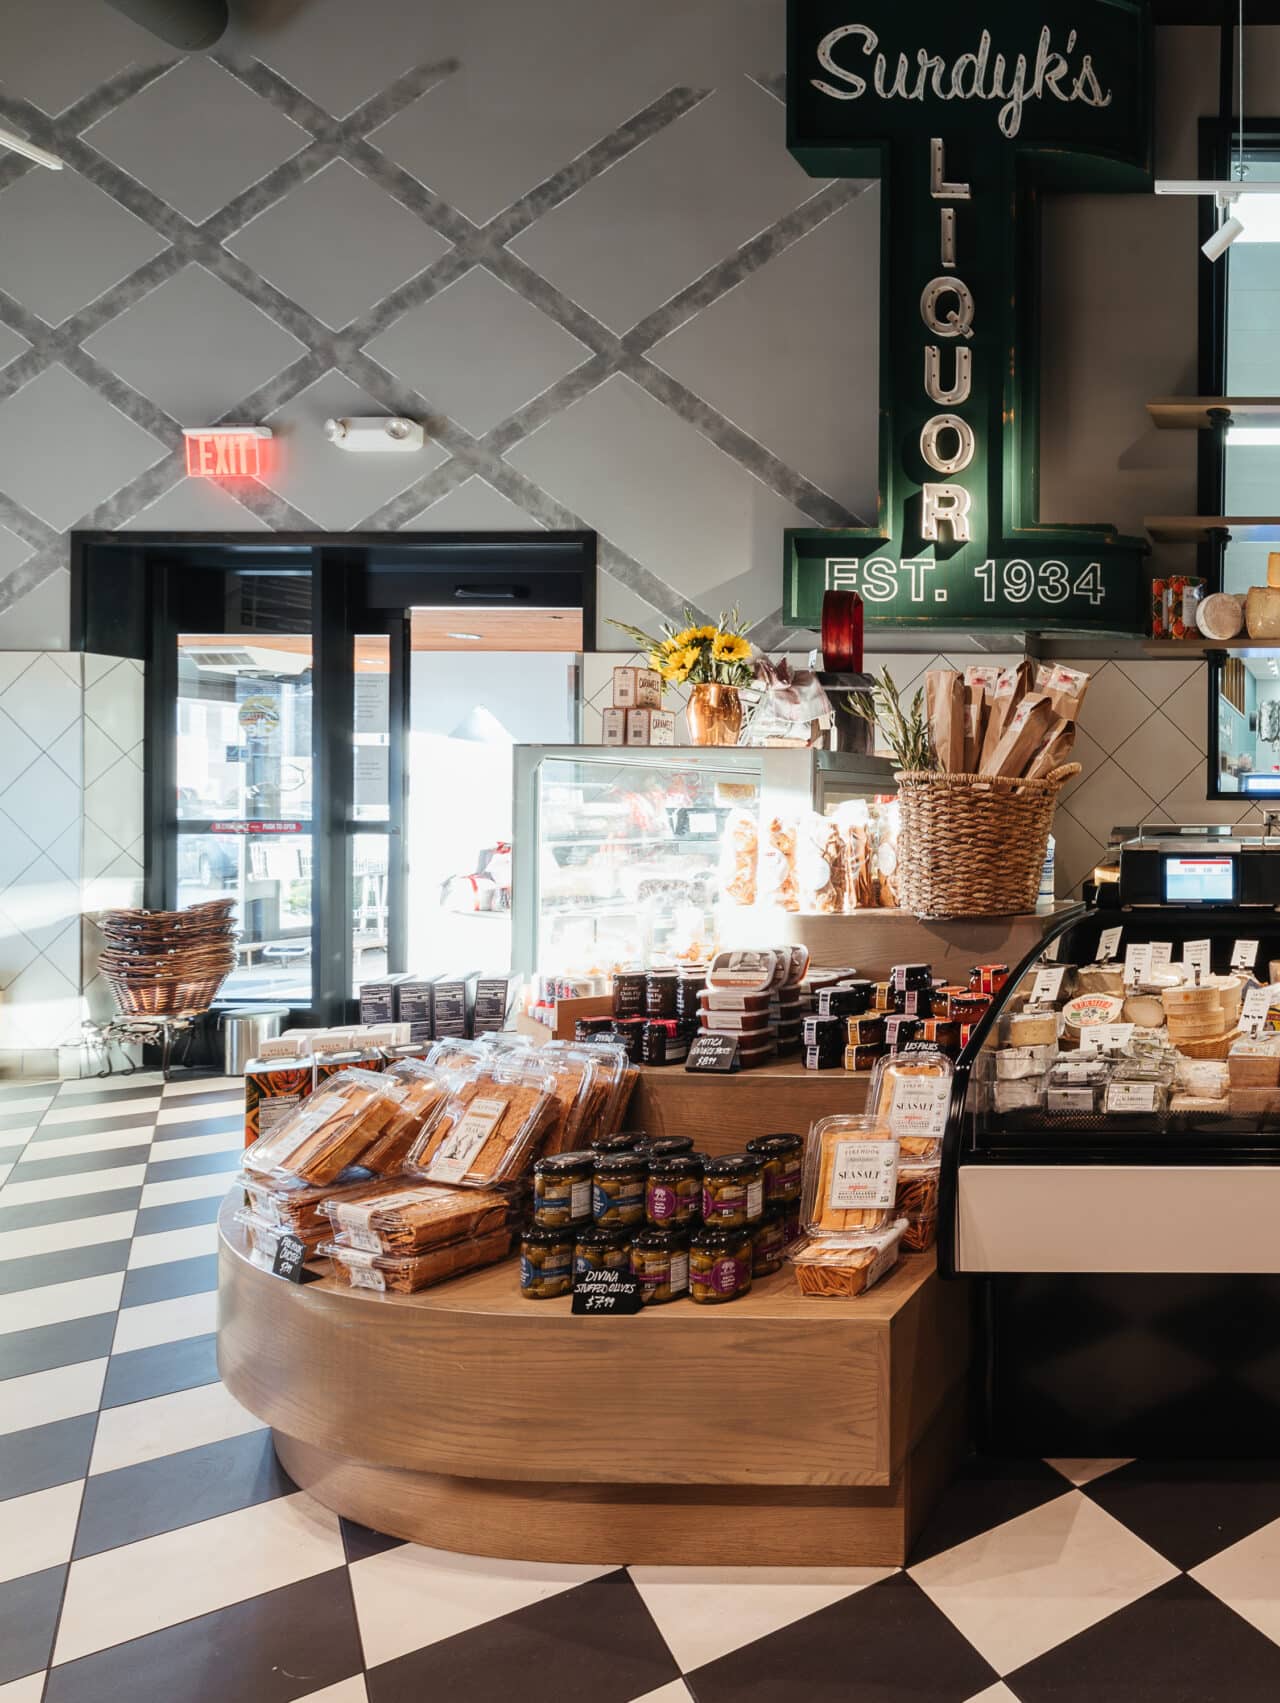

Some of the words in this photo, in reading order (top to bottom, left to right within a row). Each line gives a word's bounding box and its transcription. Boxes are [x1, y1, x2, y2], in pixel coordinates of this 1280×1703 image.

[809, 23, 1112, 138] Surdyk's
[919, 137, 975, 542] LIQUOR
[199, 435, 249, 475] EXIT
[824, 557, 948, 603] EST.
[975, 559, 1105, 605] 1934
[838, 1170, 856, 1180] SEA
[856, 1170, 880, 1179] SALT
[574, 1283, 608, 1294] STUFFED
[608, 1283, 636, 1294] OLIVES
[585, 1270, 619, 1282] DIVINA
